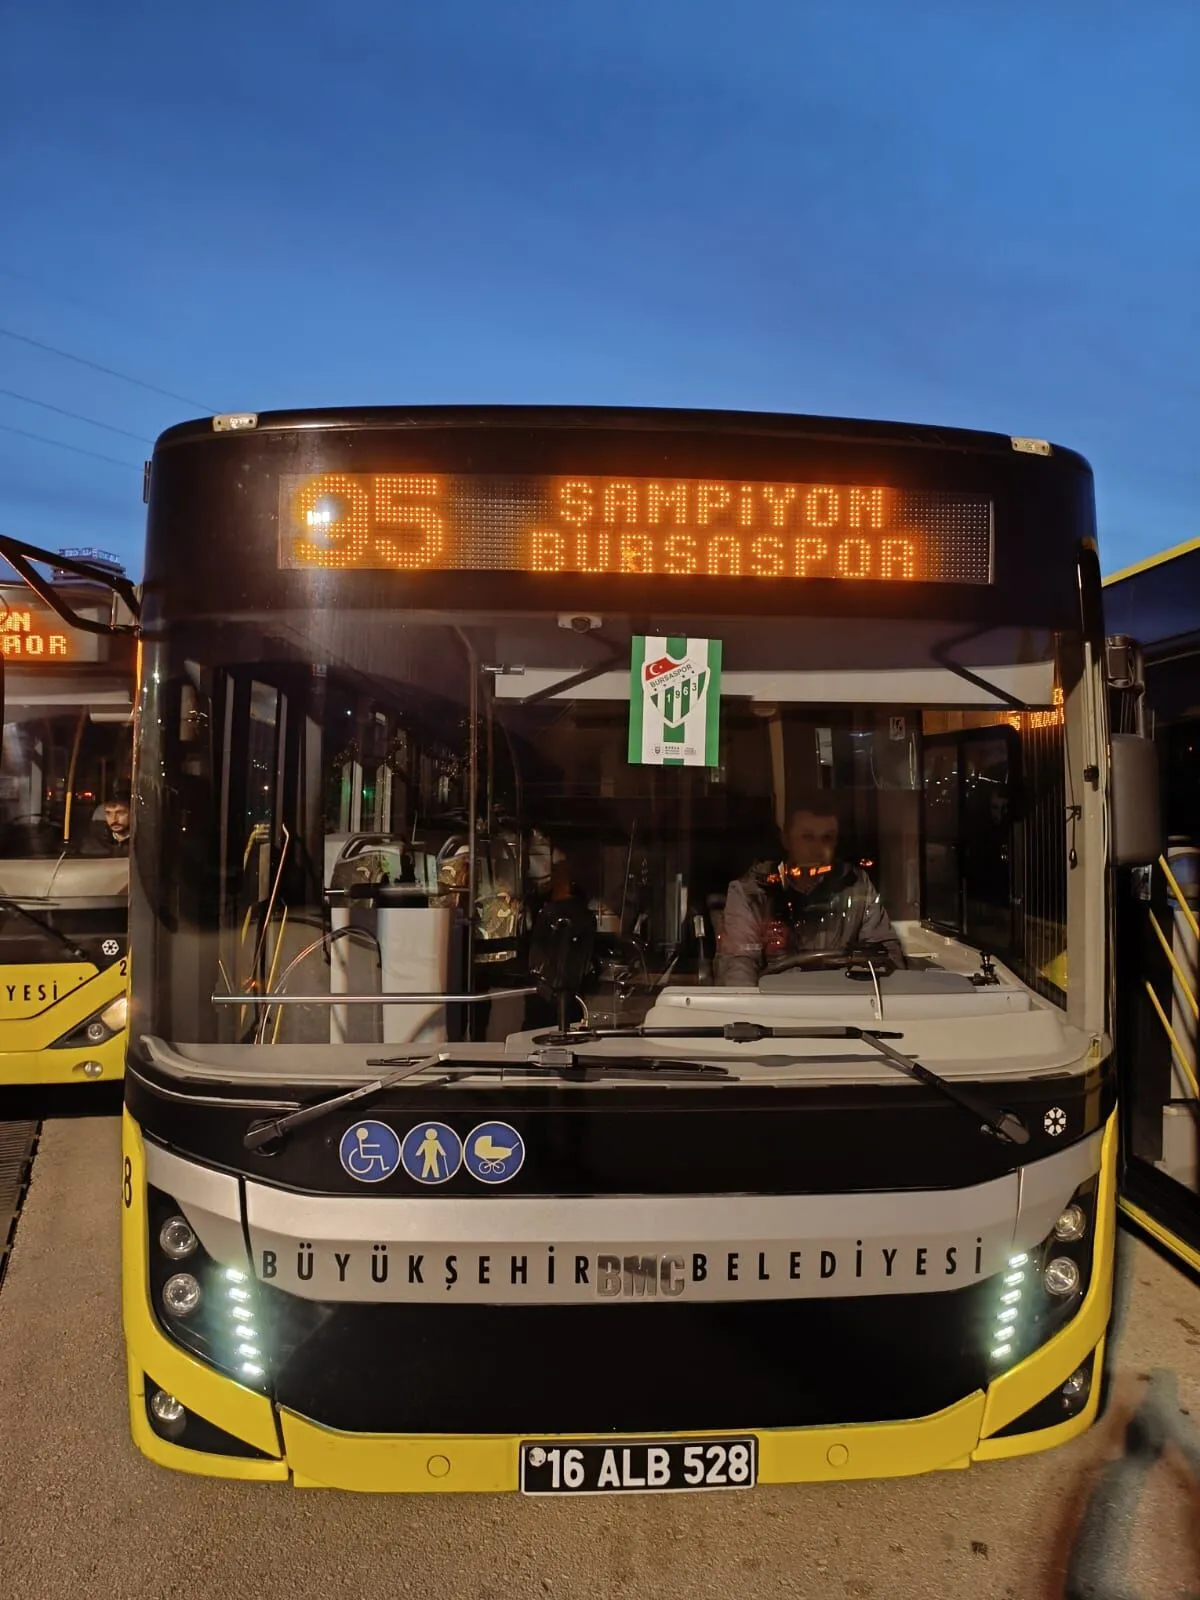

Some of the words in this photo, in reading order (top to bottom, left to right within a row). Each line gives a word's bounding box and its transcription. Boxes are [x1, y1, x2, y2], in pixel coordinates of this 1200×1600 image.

[300, 475, 443, 568] 95
[532, 531, 915, 578] BURSASPOR
[649, 663, 693, 688] BURSASPOR
[665, 682, 698, 704] 1963
[6, 980, 58, 1001] YESİ
[262, 1242, 590, 1291] BÜYÜKŞEHİR
[597, 1253, 685, 1298] BMC
[692, 1237, 983, 1282] BELEDİYESİ
[547, 1448, 585, 1488] 16
[597, 1447, 671, 1487] ALB
[683, 1444, 749, 1485] 528
